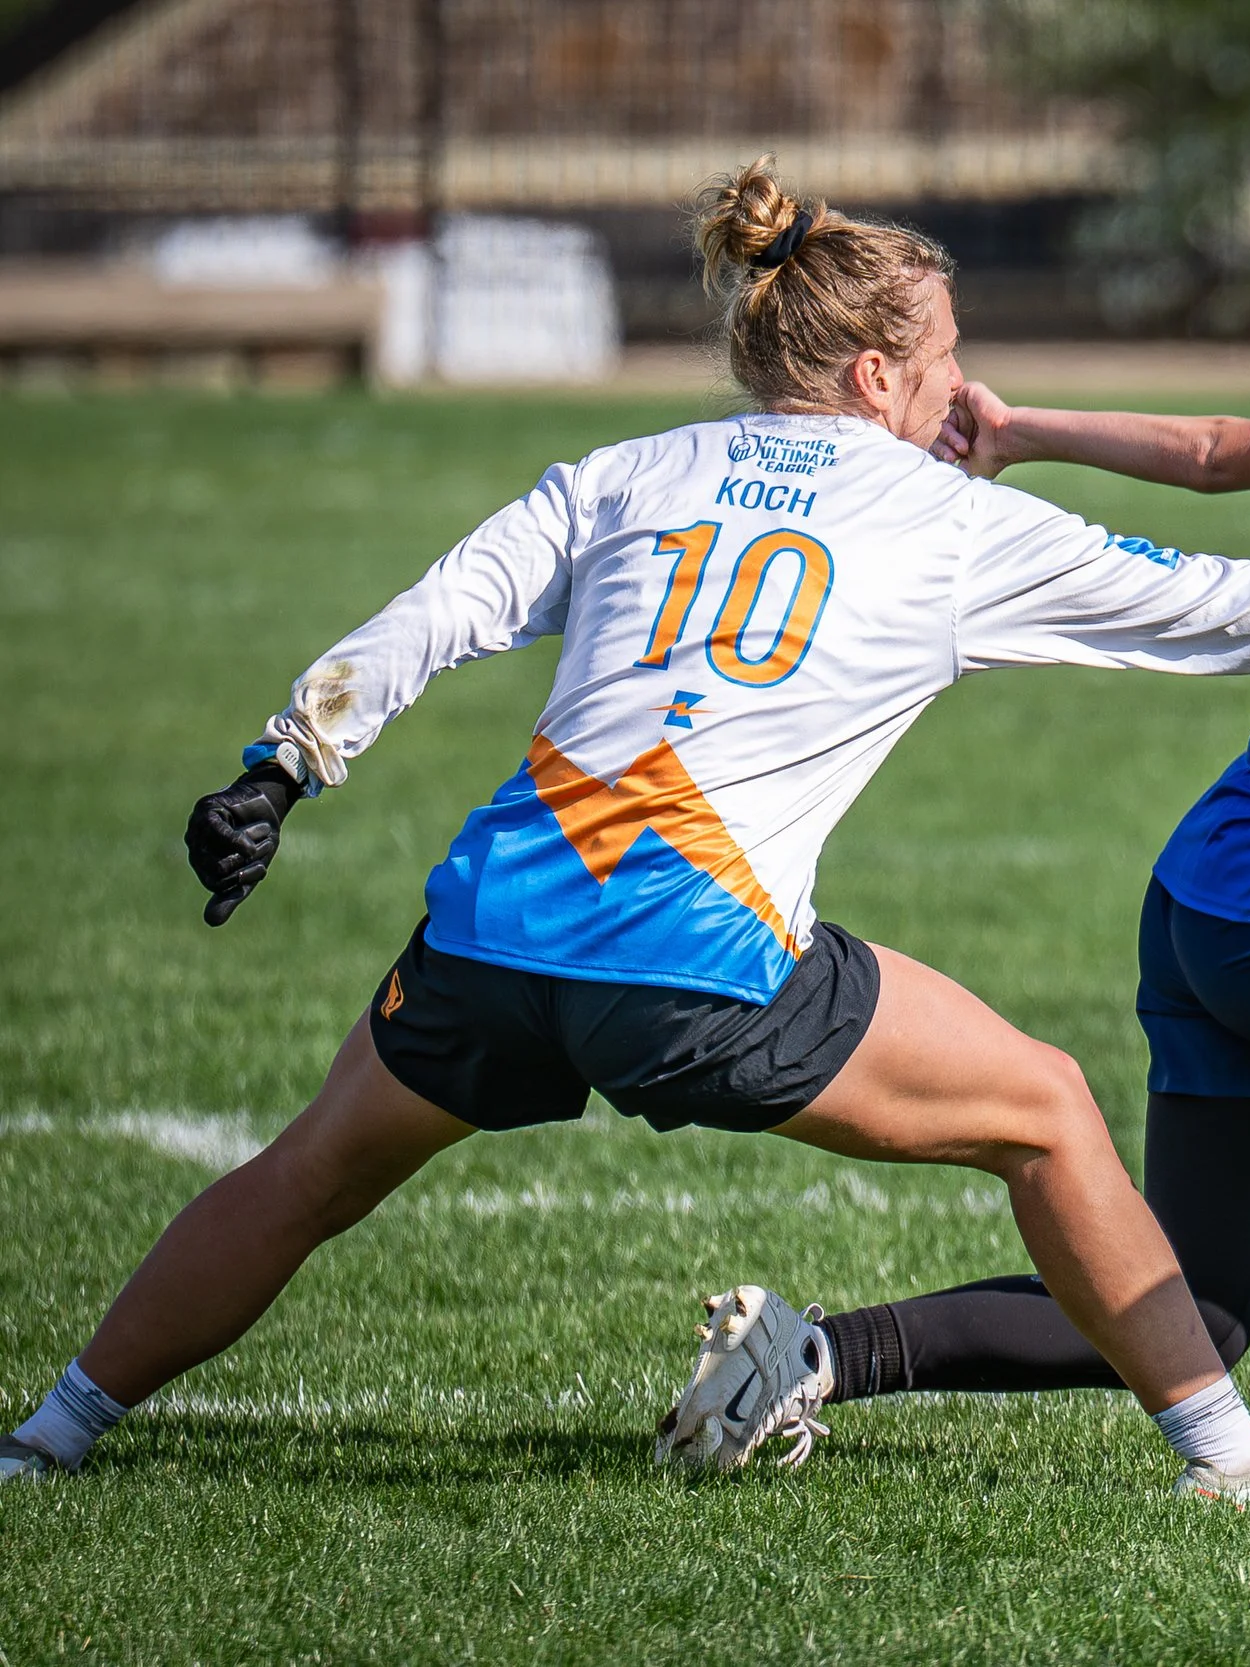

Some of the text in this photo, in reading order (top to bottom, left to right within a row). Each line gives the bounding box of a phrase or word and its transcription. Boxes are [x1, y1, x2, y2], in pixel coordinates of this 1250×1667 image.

[762, 435, 837, 456] PREMIER
[760, 446, 840, 467] ULTIMATE
[757, 460, 818, 477] LEAGUE
[714, 476, 817, 517] KOCH
[632, 519, 835, 689] 10
